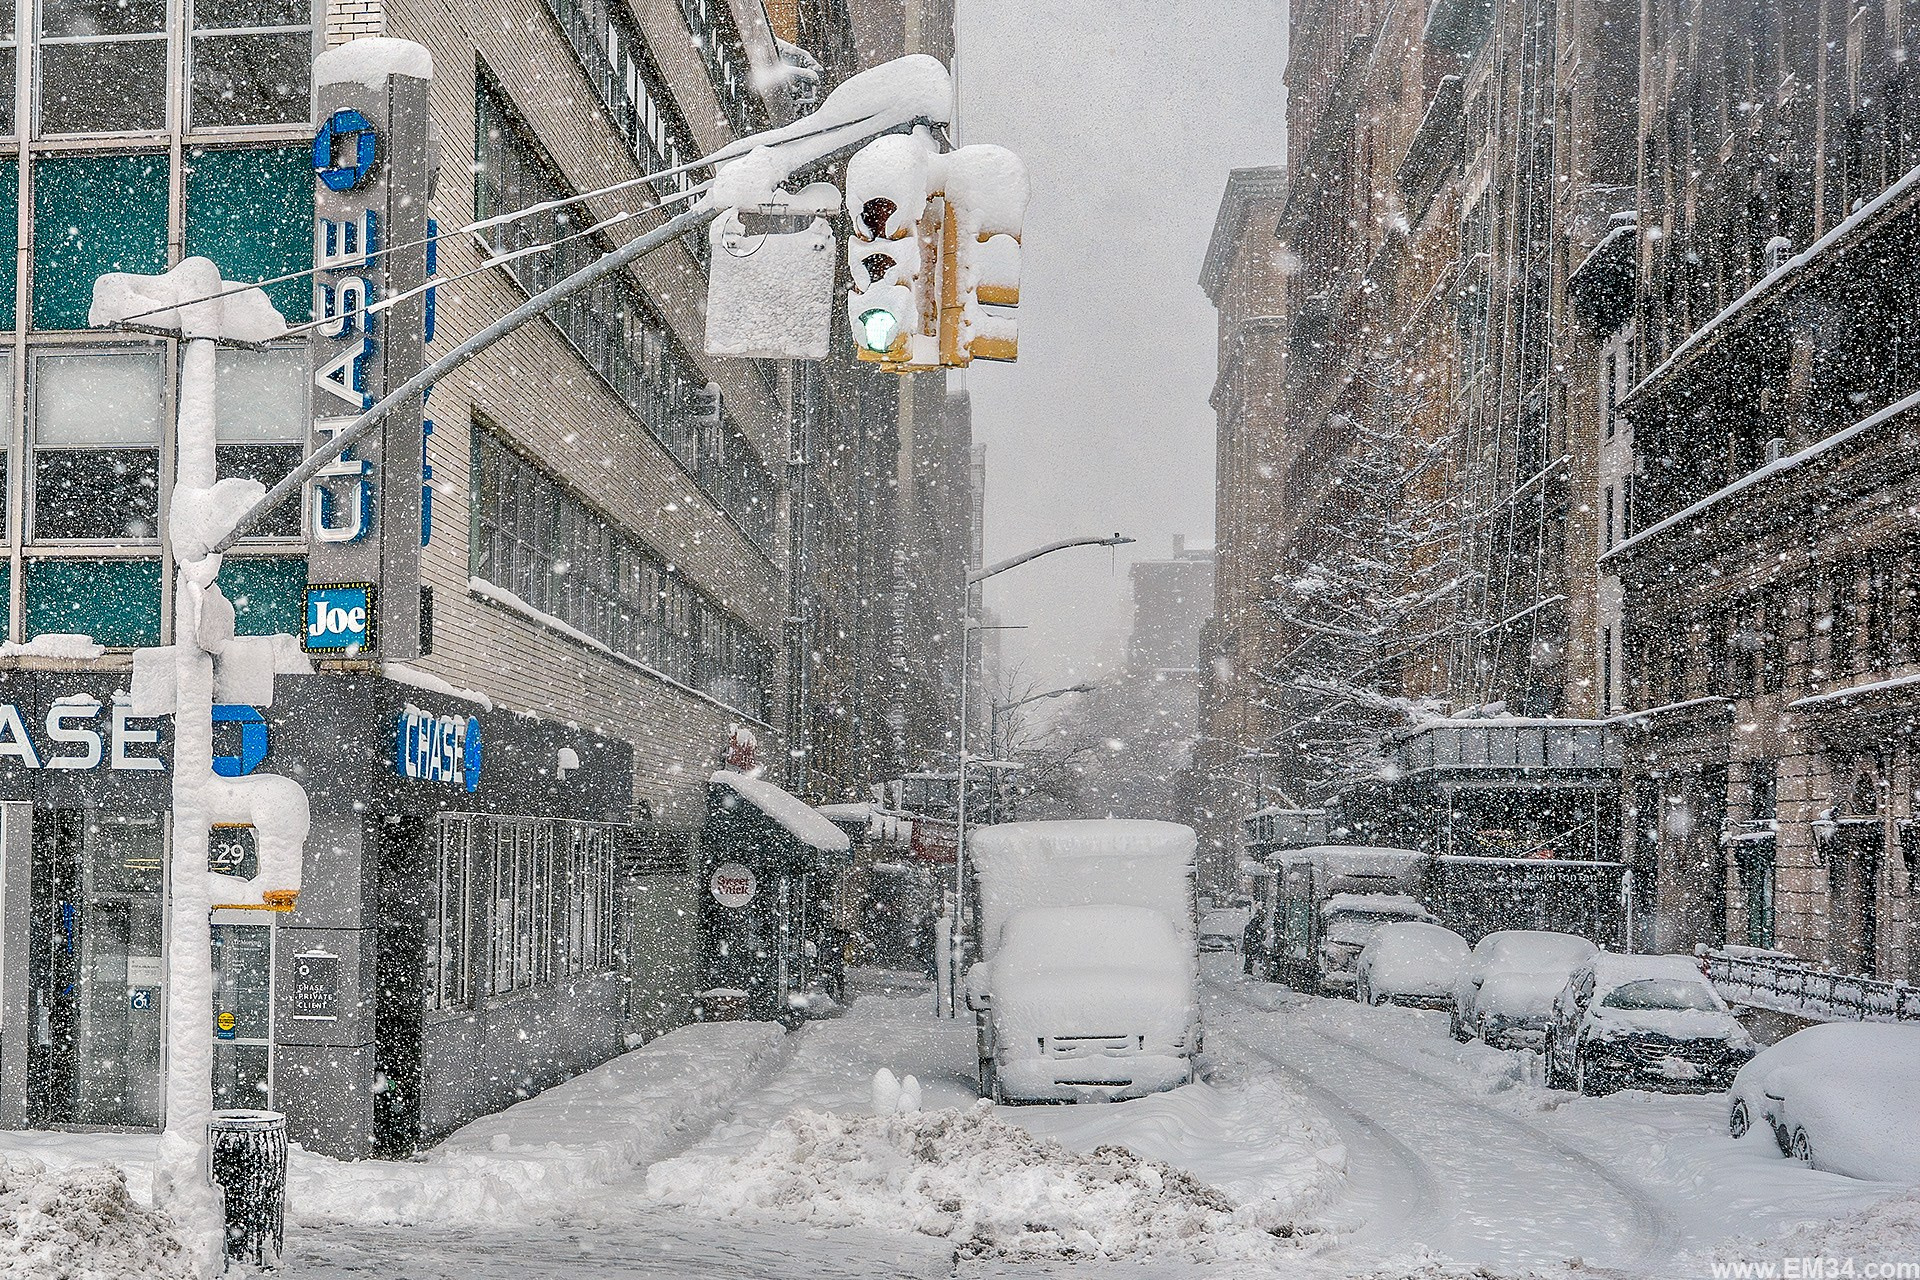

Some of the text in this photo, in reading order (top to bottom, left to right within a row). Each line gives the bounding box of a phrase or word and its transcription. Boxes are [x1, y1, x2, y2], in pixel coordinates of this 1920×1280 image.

[313, 209, 374, 543] CHASE
[309, 601, 366, 636] Joe
[402, 713, 465, 783] CHASE
[217, 844, 245, 865] 29
[298, 984, 325, 992] CHASE
[298, 993, 334, 1001] PRIVATE
